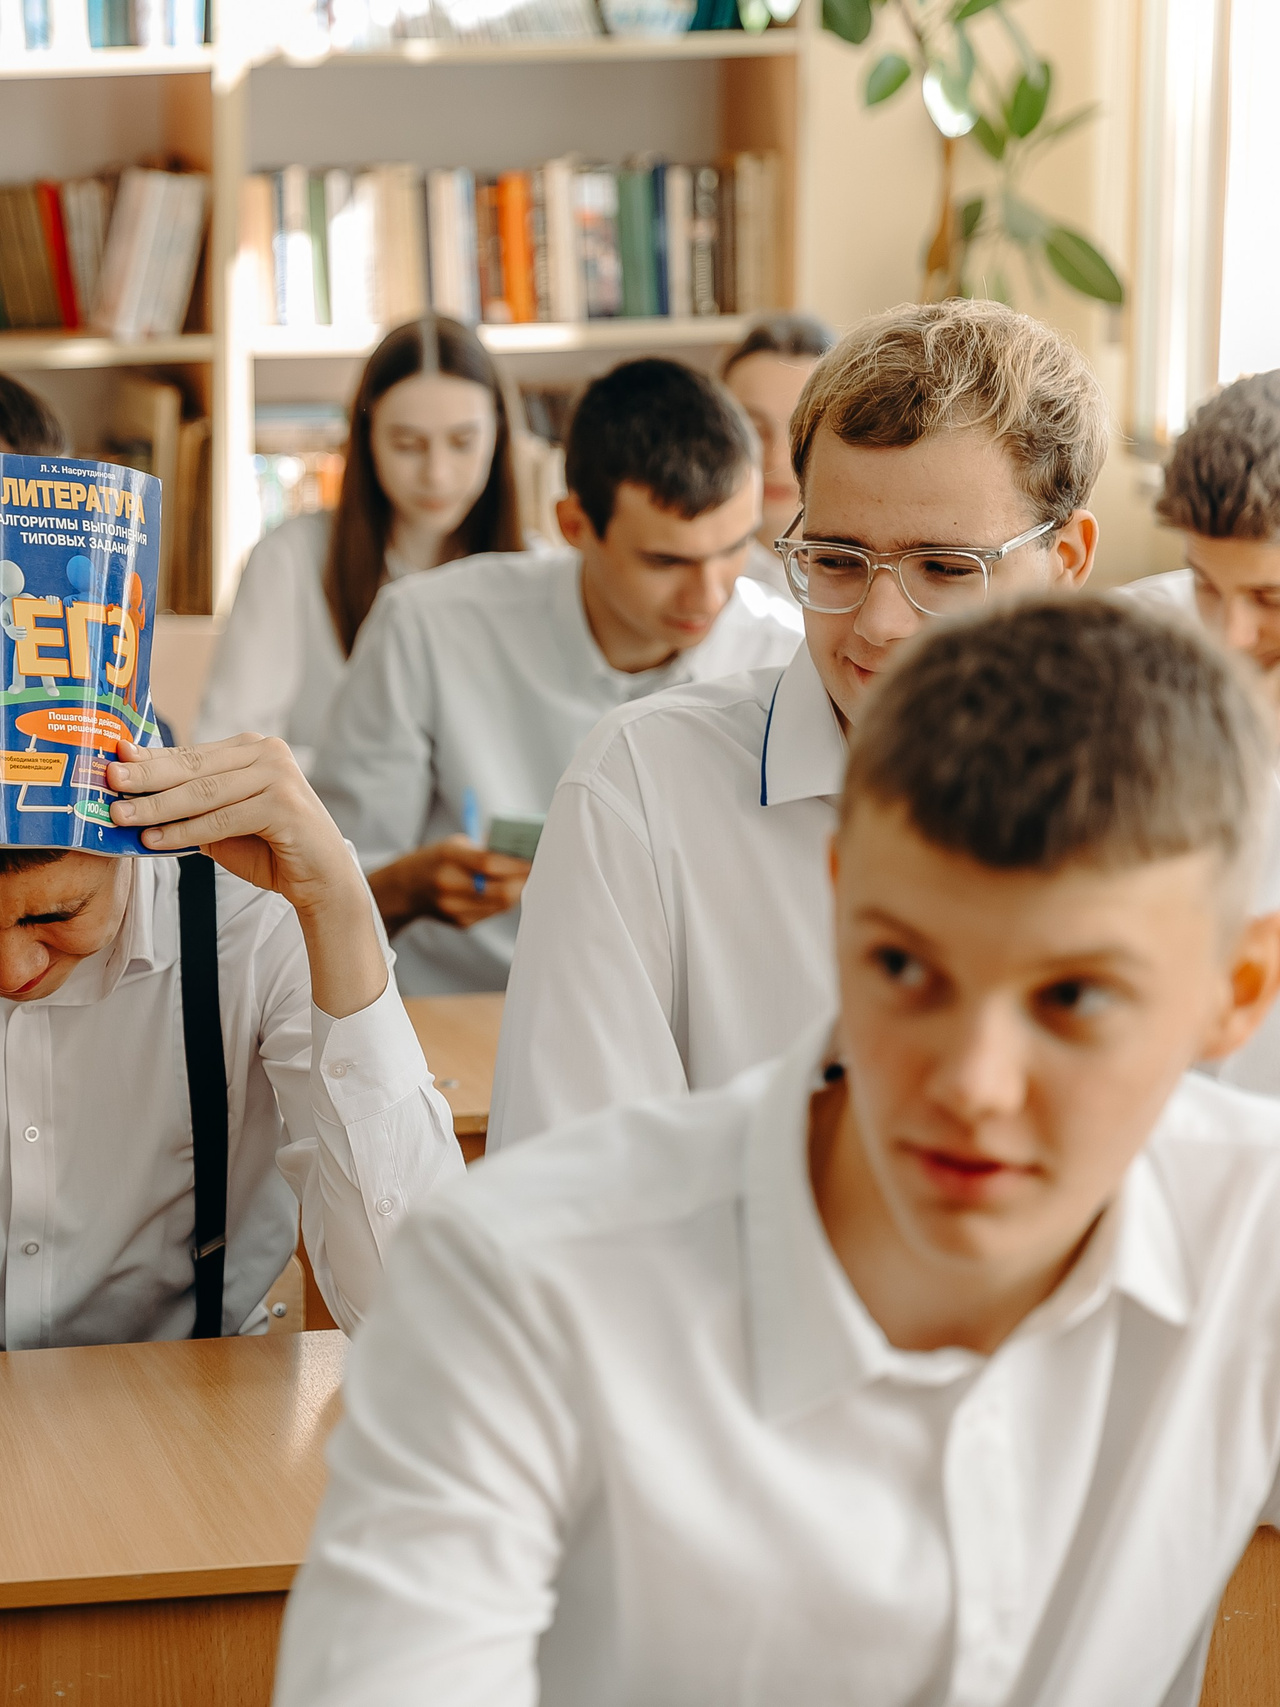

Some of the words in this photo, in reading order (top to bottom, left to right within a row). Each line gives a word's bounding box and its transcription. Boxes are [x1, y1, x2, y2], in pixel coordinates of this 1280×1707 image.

[40, 464, 50, 473] Л.
[61, 466, 116, 480] Насрутдинова
[1, 477, 146, 525] ЛИТЕРАТУРА
[82, 520, 148, 546] ВЫПОЛНЕНИЯ
[20, 532, 87, 548] ТИПОВЫХ
[89, 537, 136, 558] ЗАДАНИЙ
[12, 597, 138, 688] ЕГЭ
[48, 711, 98, 724] Пошаговые
[48, 723, 66, 732] при
[67, 724, 103, 735] решении
[87, 803, 100, 815] 100
